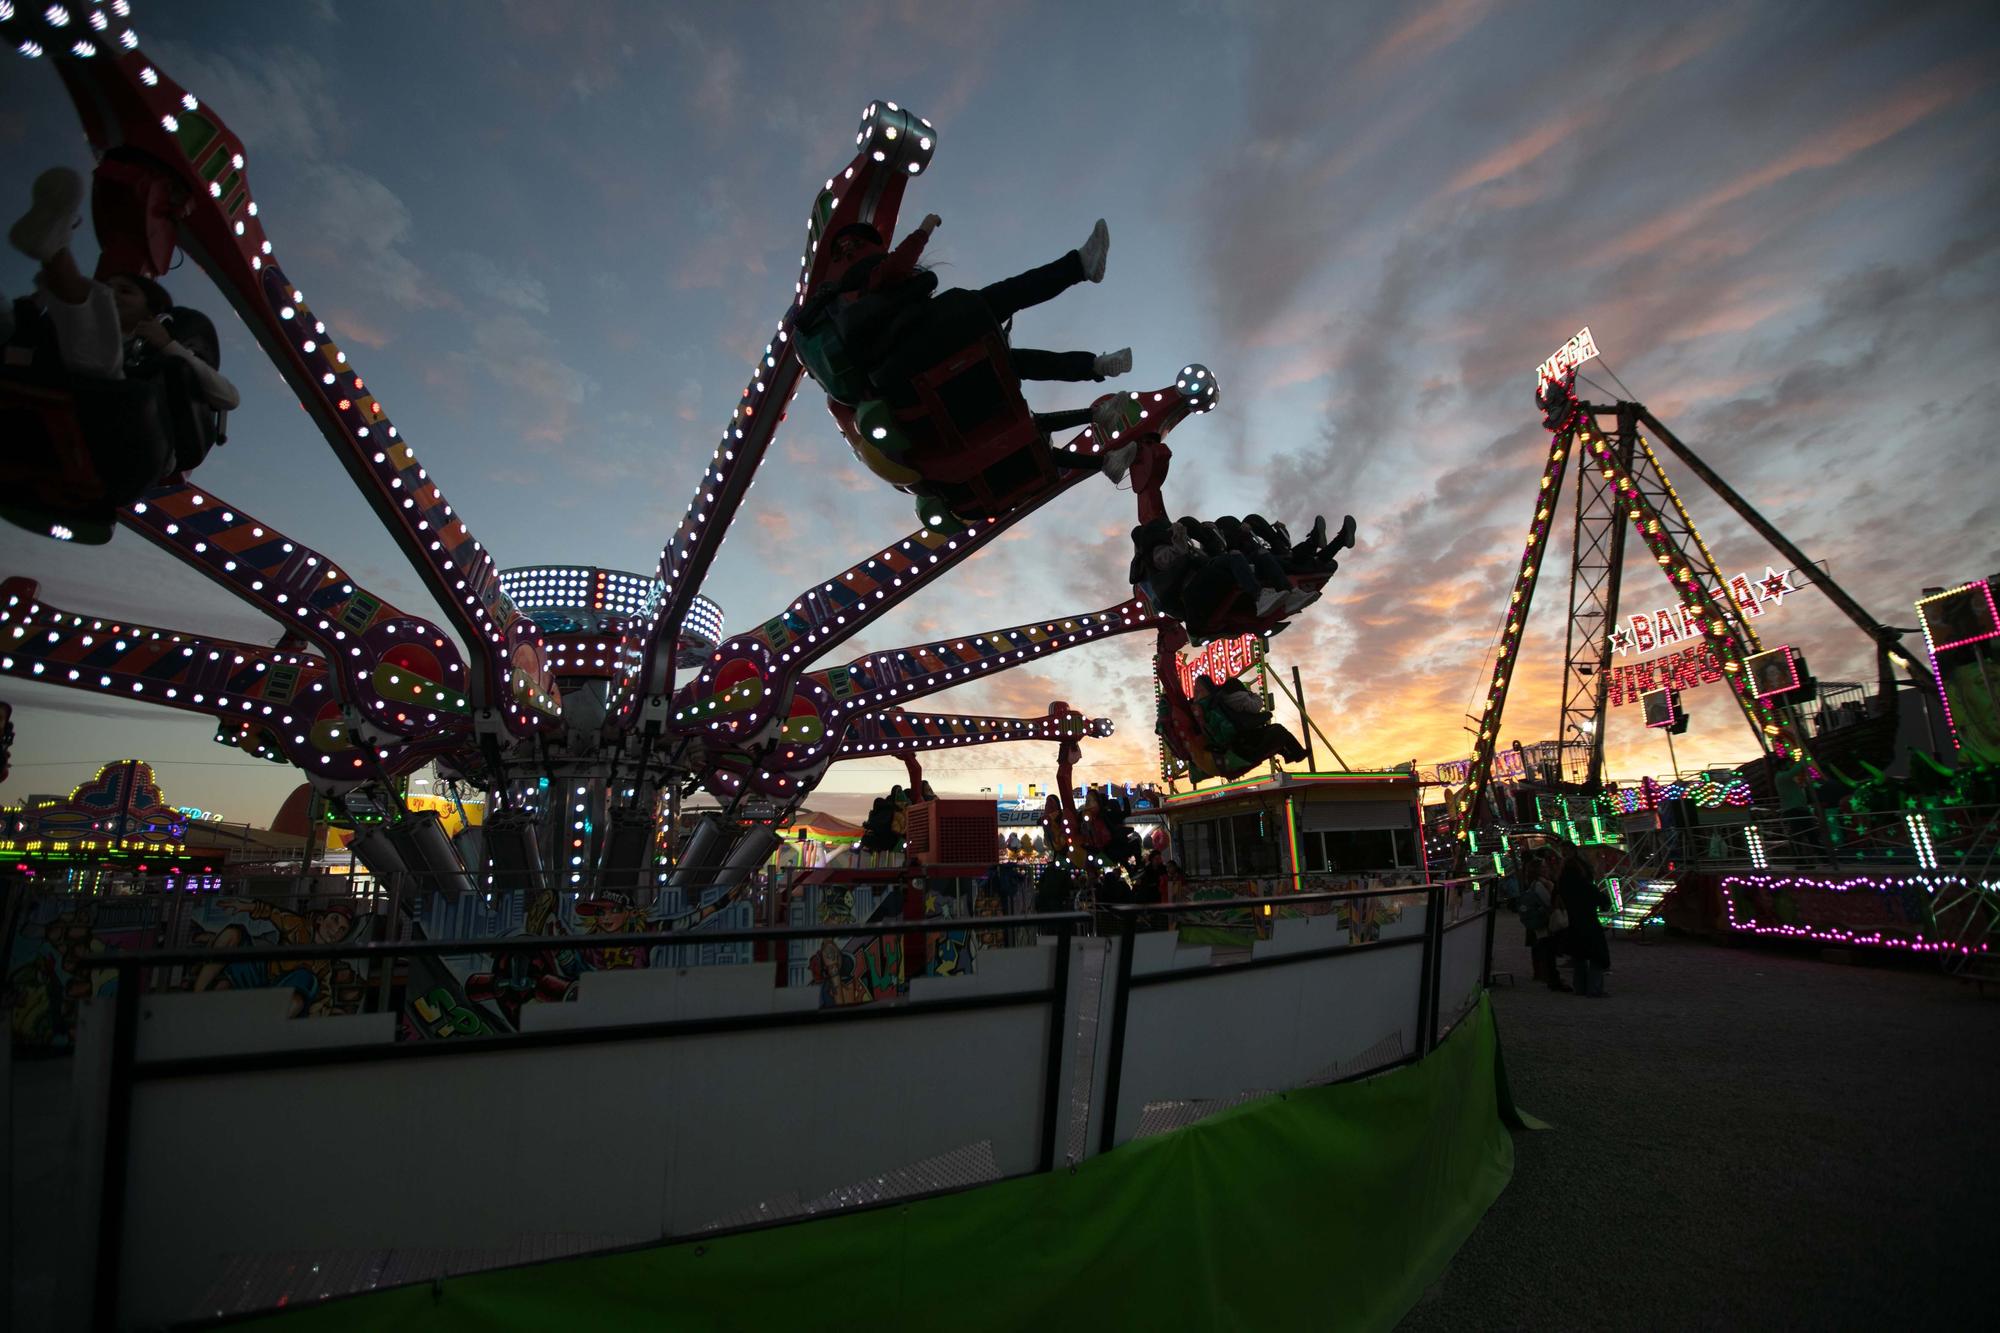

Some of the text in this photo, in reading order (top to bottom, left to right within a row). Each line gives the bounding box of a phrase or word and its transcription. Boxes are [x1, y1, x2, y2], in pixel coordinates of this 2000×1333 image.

[1535, 326, 1601, 399] MEGA
[1626, 571, 1766, 655] BARA
[651, 695, 662, 707] 6
[999, 811, 1046, 823] SUPE
